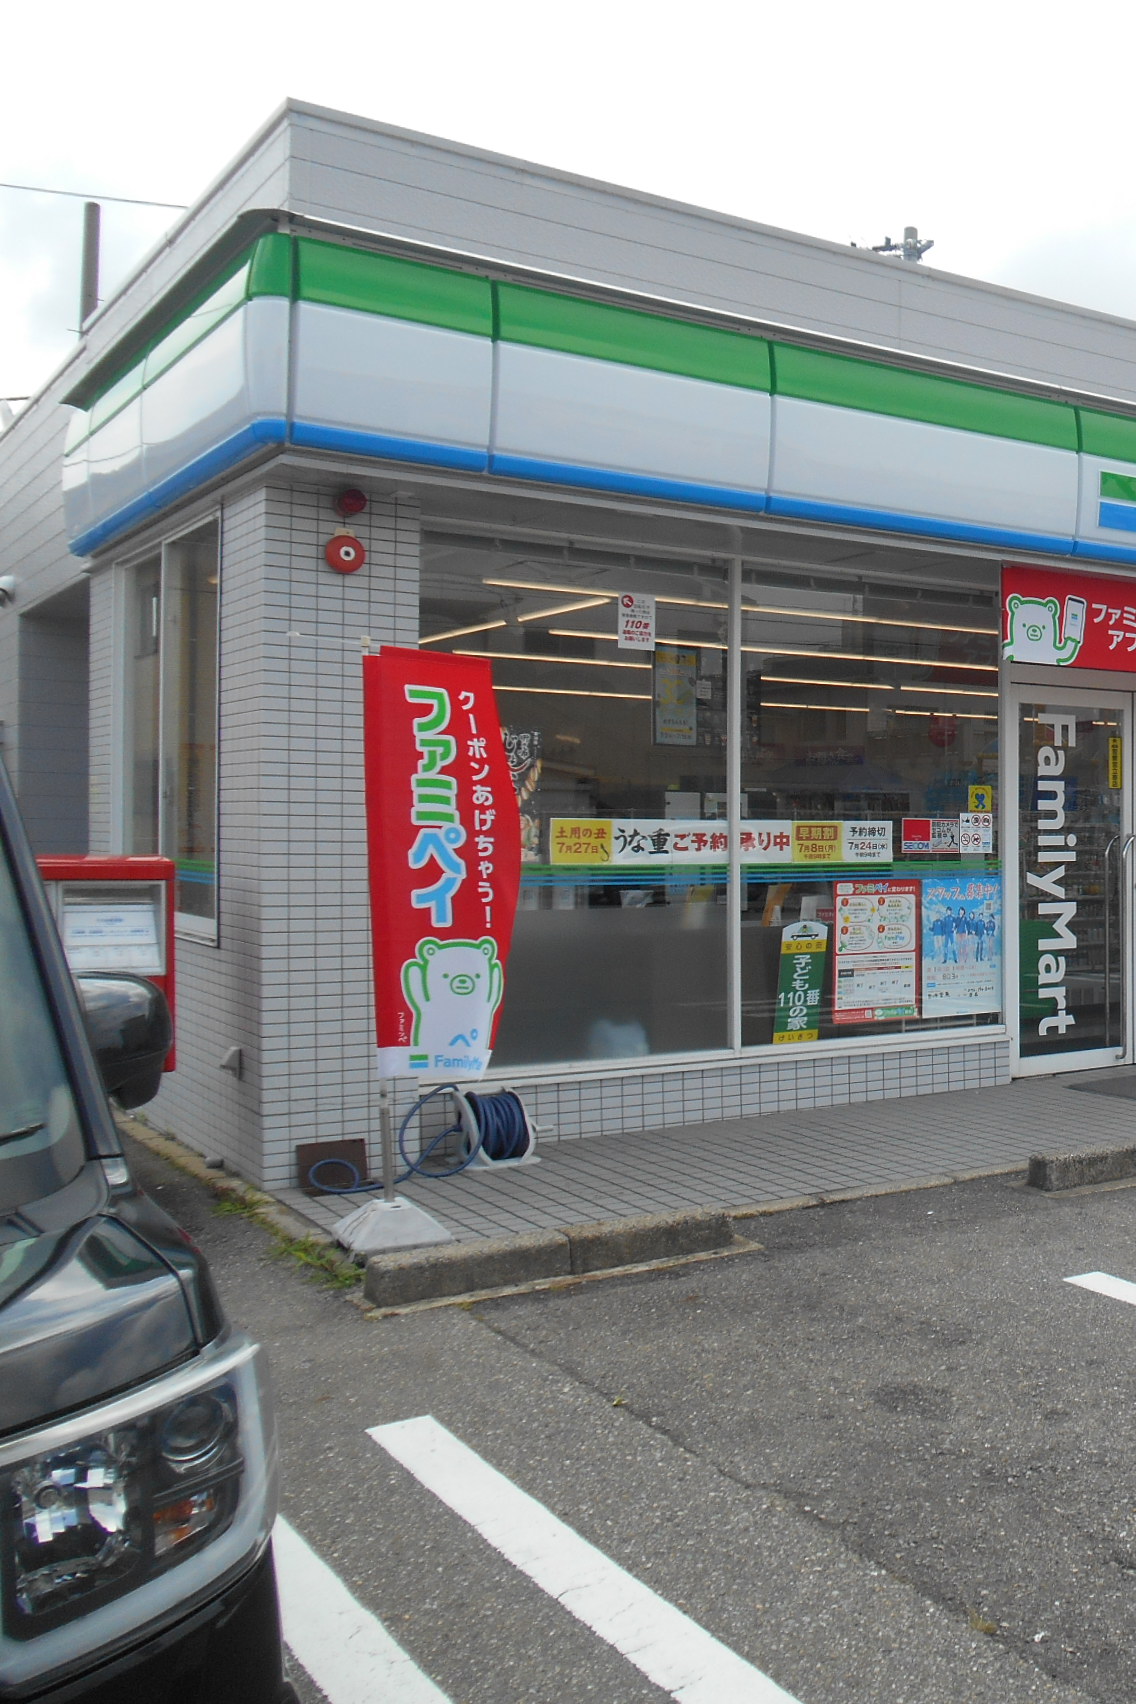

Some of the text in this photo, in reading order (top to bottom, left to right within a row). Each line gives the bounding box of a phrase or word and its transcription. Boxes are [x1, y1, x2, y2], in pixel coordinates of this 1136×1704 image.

[404, 684, 467, 928] ファミペイ
[555, 826, 607, 840] 土用の丑
[849, 826, 886, 838] 予約締切
[556, 841, 599, 854] 7月27日
[903, 842, 930, 850] SECOM
[1027, 713, 1077, 1036] FamilyMart
